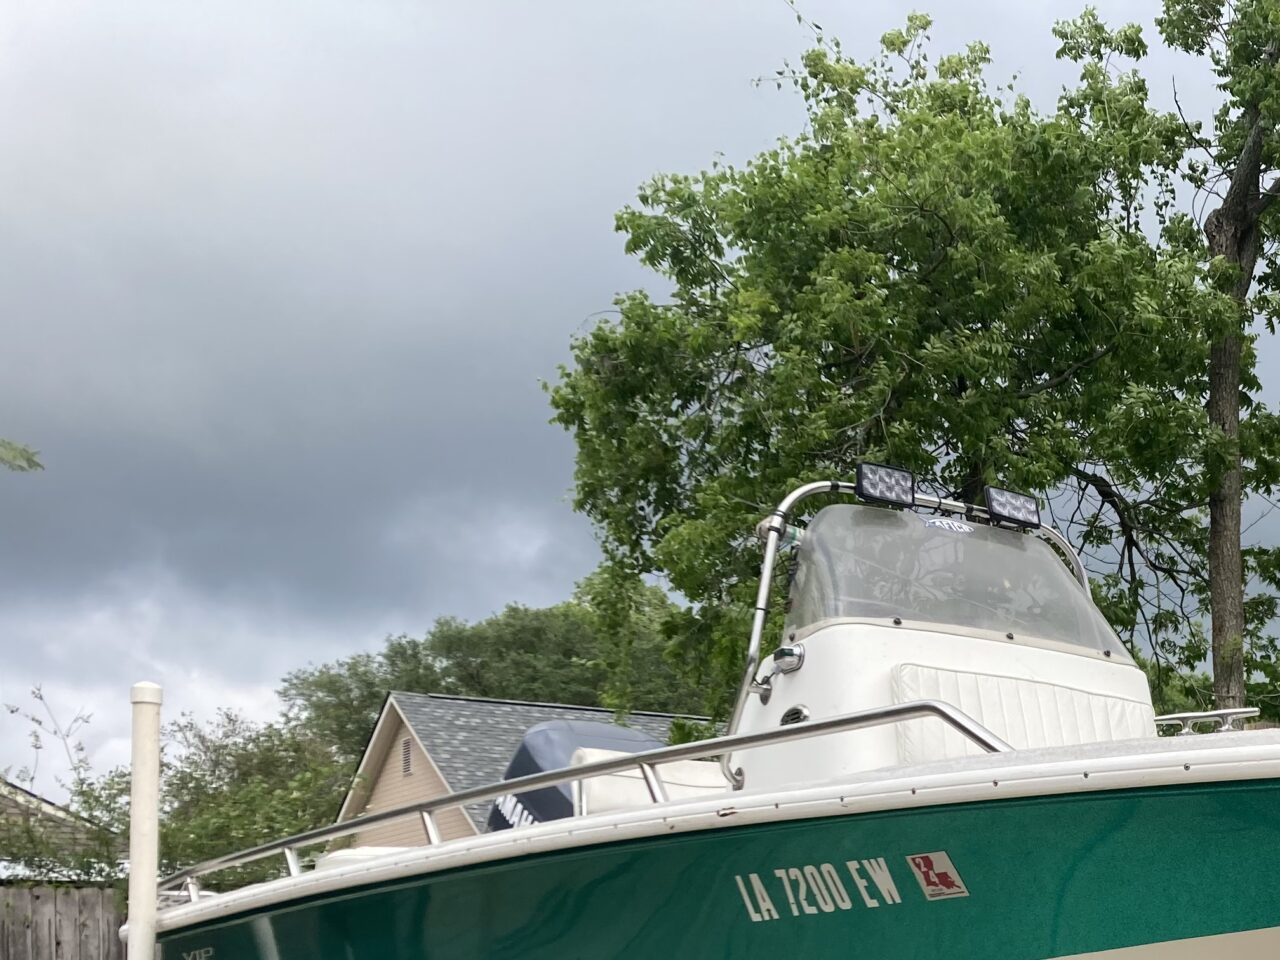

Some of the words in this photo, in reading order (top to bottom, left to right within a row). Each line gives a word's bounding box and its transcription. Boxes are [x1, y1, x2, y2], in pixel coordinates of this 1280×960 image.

[735, 873, 780, 922] LA
[774, 863, 853, 916] 7200
[846, 857, 902, 908] EW
